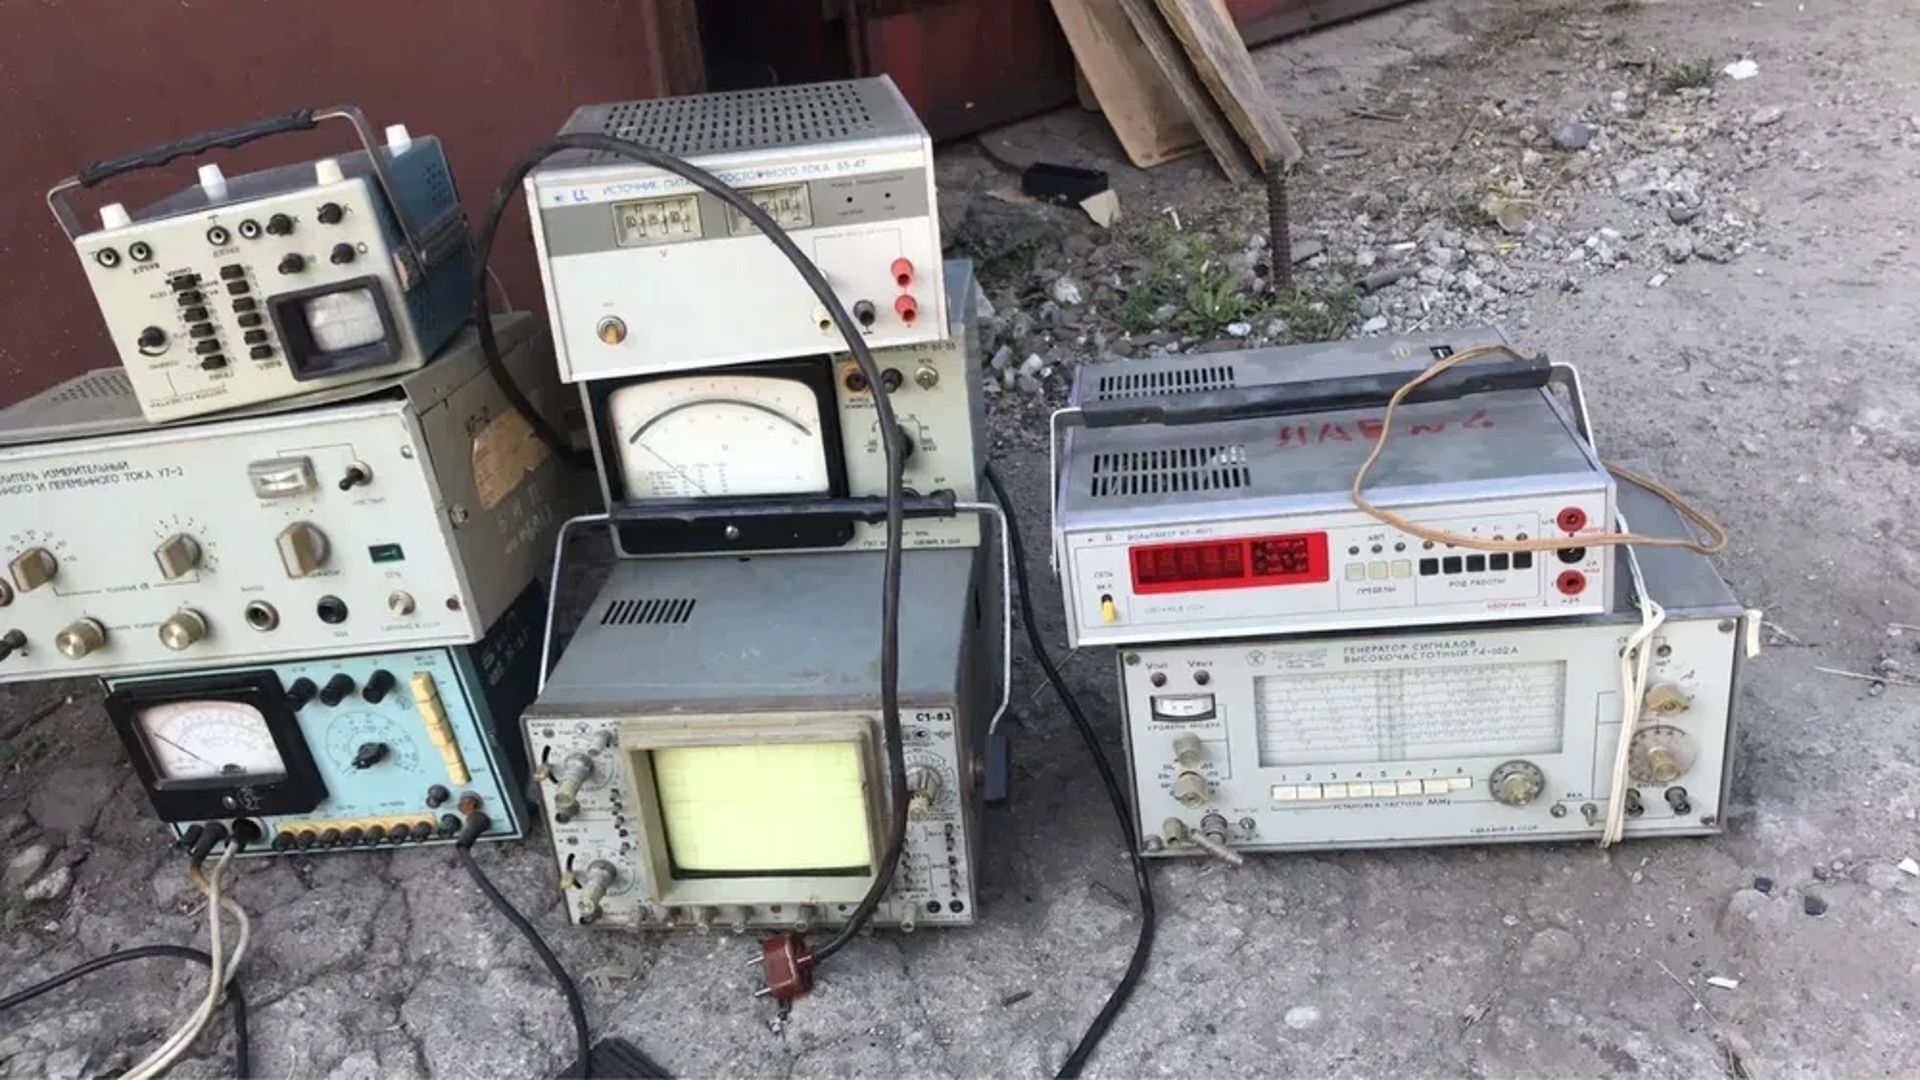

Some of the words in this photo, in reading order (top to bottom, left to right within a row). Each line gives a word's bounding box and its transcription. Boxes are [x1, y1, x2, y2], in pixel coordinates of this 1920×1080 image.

[1344, 642, 1407, 655] ГЕНЕРАТОР
[1414, 639, 1477, 651] СИГНАЛОВ
[1344, 649, 1468, 664] ВЫСОКОЧАСТОТНЫЙ
